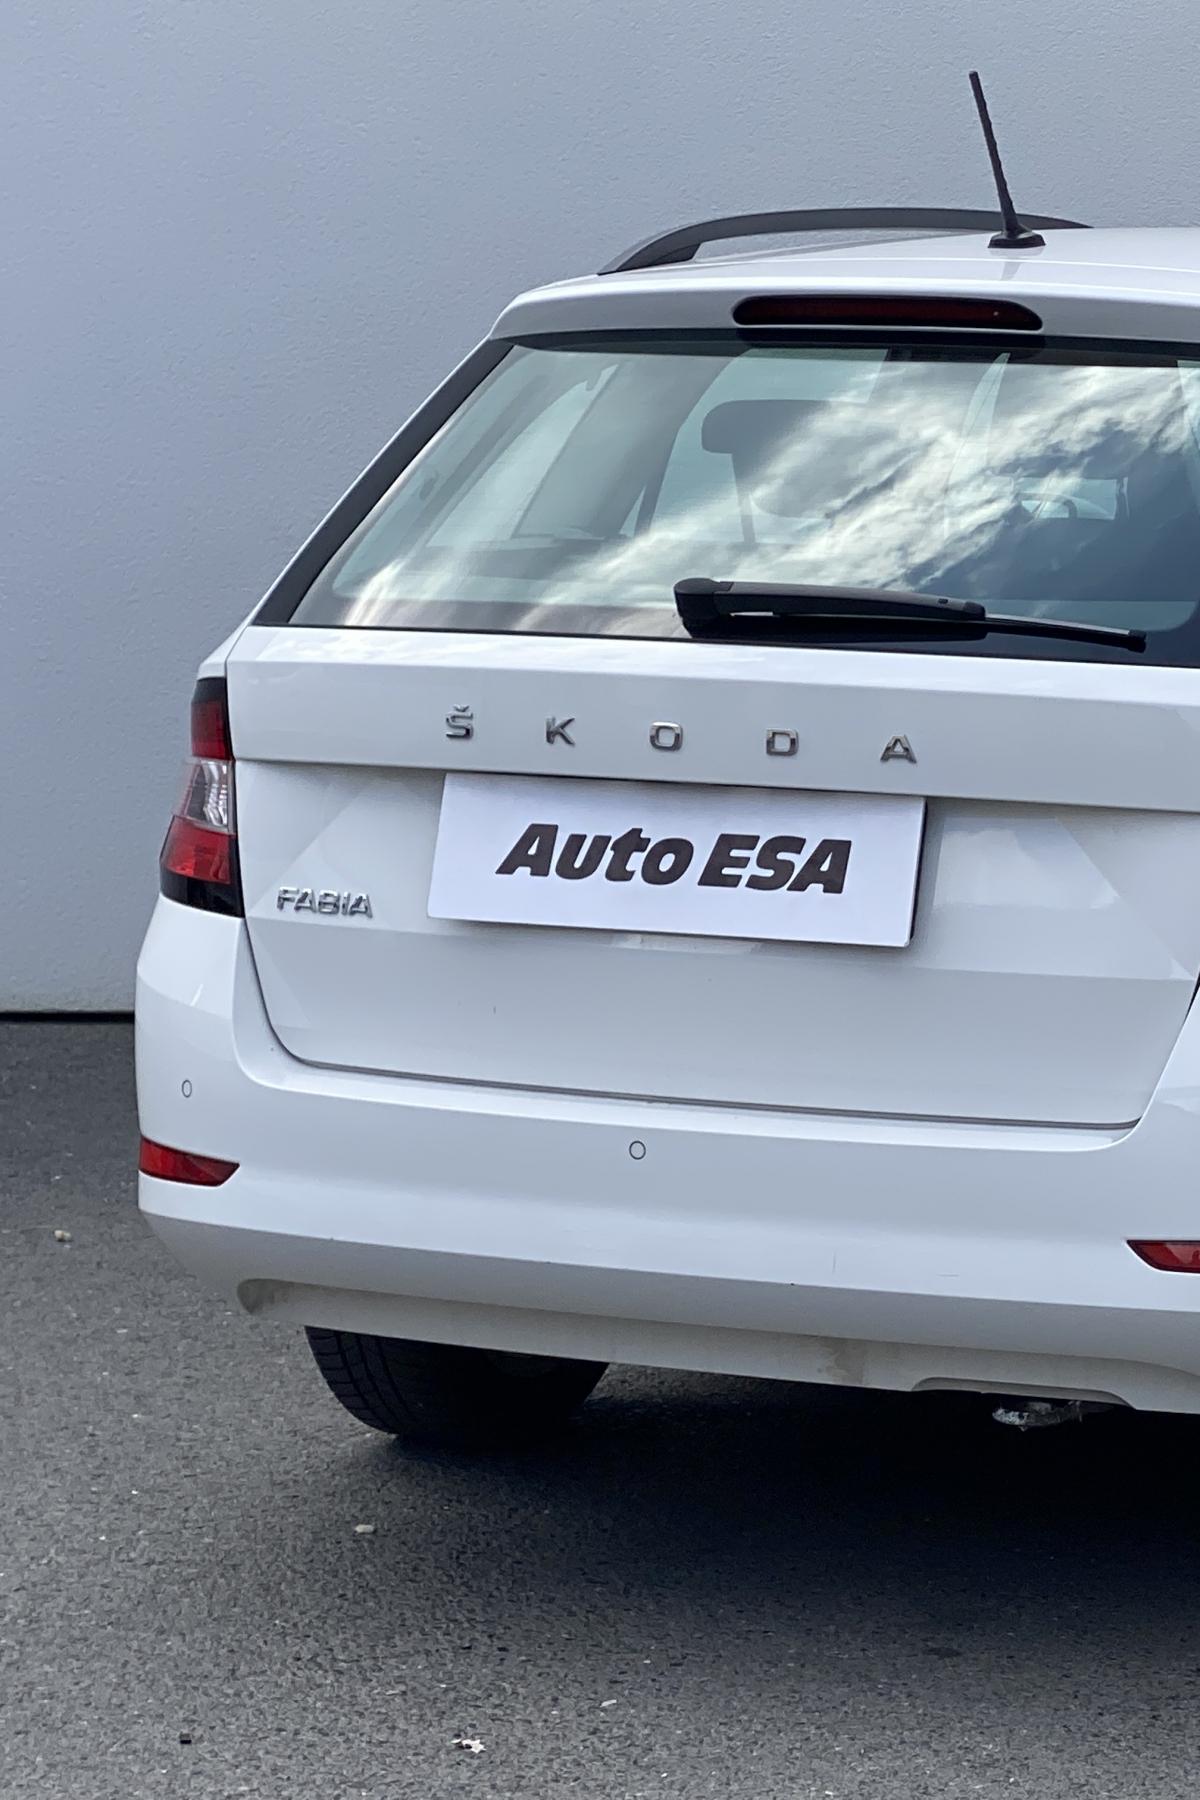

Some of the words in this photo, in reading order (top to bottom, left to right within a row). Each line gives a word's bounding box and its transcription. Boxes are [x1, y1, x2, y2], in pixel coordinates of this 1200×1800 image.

[446, 705, 918, 764] ŠKODA
[494, 823, 695, 885] Auto
[697, 833, 852, 894] ESA
[277, 886, 373, 919] FABIA
